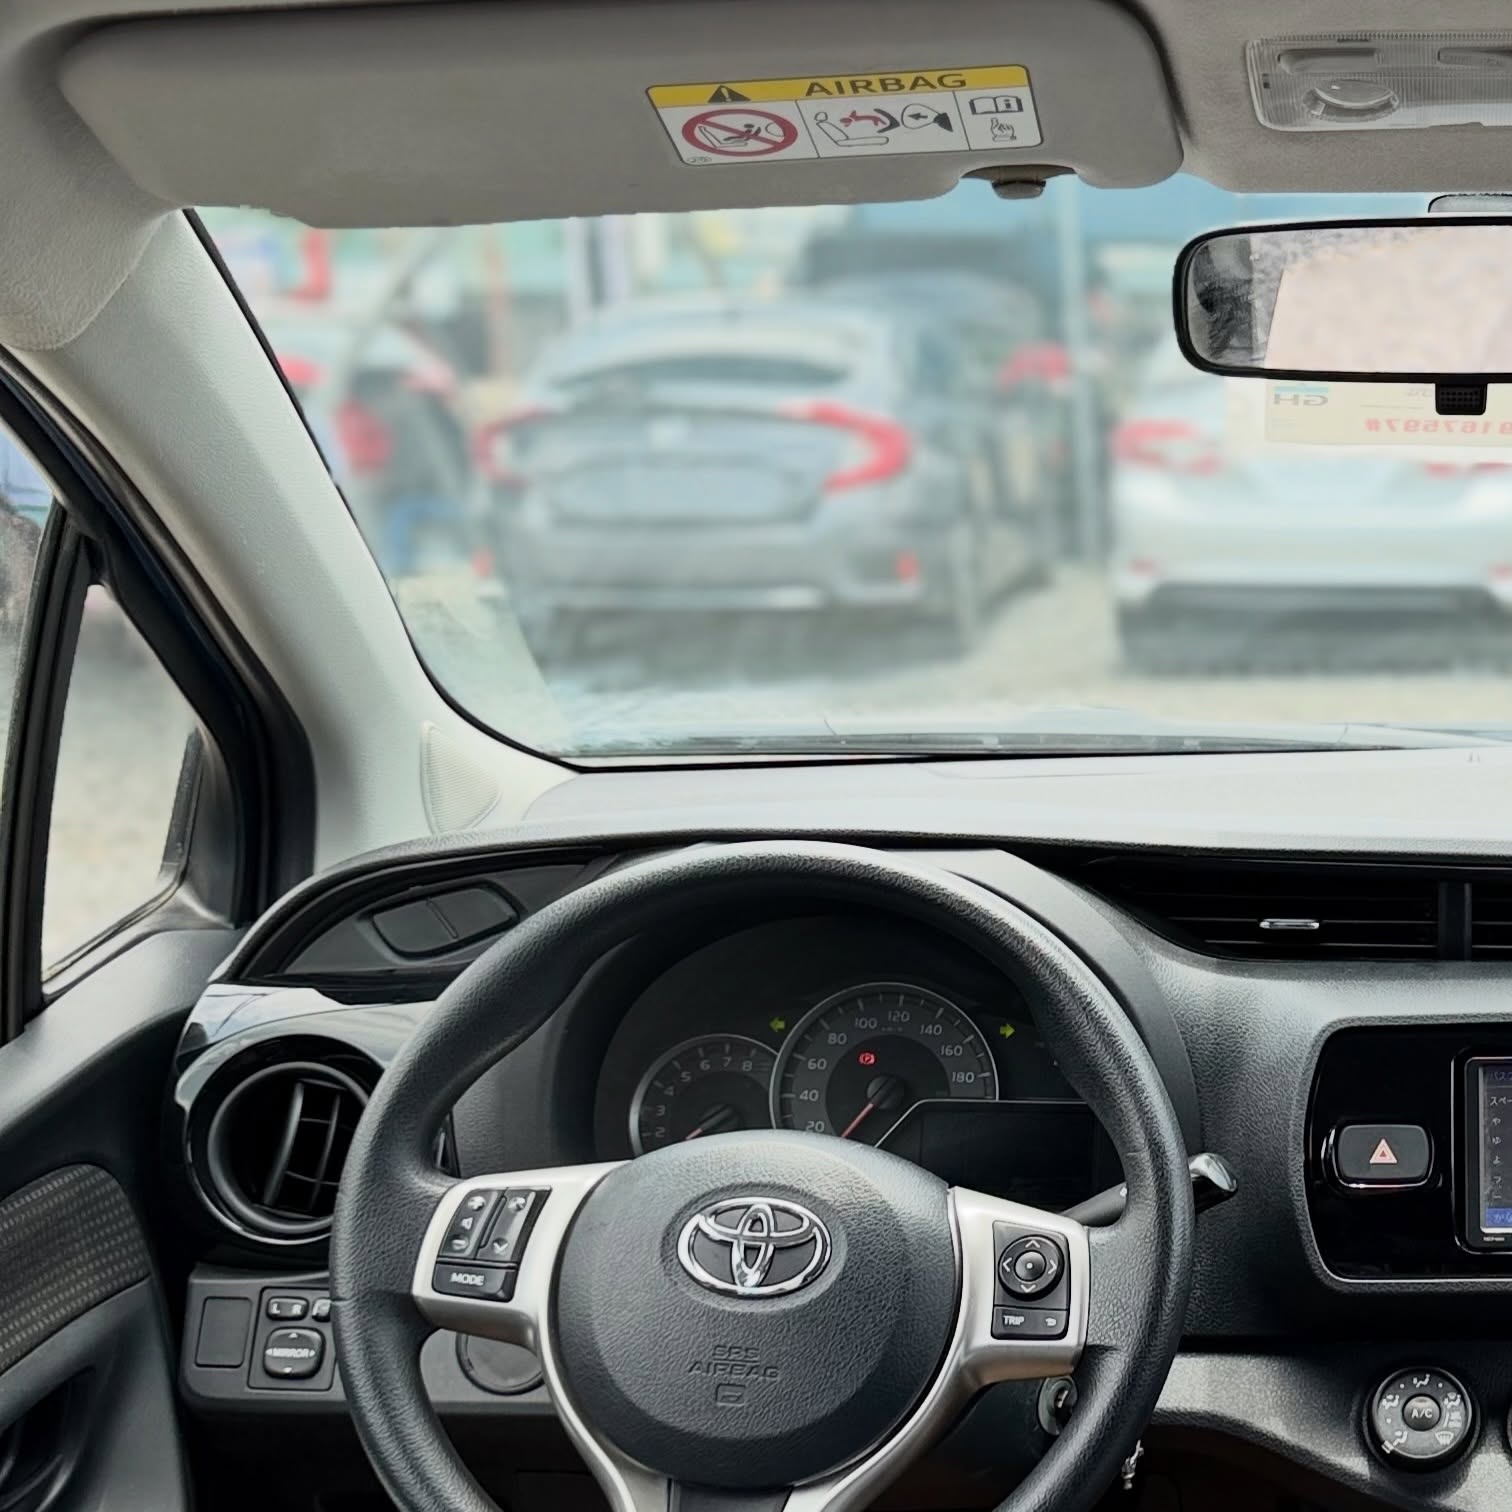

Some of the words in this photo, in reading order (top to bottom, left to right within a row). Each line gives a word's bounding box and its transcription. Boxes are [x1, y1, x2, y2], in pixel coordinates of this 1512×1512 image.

[805, 73, 967, 98] AIRBAG
[888, 1011, 910, 1023] 120
[855, 1017, 878, 1030] 100
[920, 1024, 943, 1036] 140
[827, 1033, 847, 1045] 80
[940, 1045, 963, 1057] 160
[700, 1060, 711, 1071] 6
[742, 1060, 753, 1072] 8
[807, 1058, 828, 1070] 60
[680, 1071, 691, 1082] 5
[952, 1072, 975, 1084] 180
[800, 1089, 819, 1101] 40
[656, 1104, 666, 1117] 3
[655, 1126, 665, 1138] 2
[806, 1121, 825, 1133] 20
[451, 1272, 485, 1286] MODE
[271, 1303, 281, 1314] L
[1003, 1315, 1025, 1326] TRIP
[712, 1345, 760, 1360] SRS
[687, 1361, 779, 1378] AIRBAG
[1411, 1407, 1433, 1419] A/C
